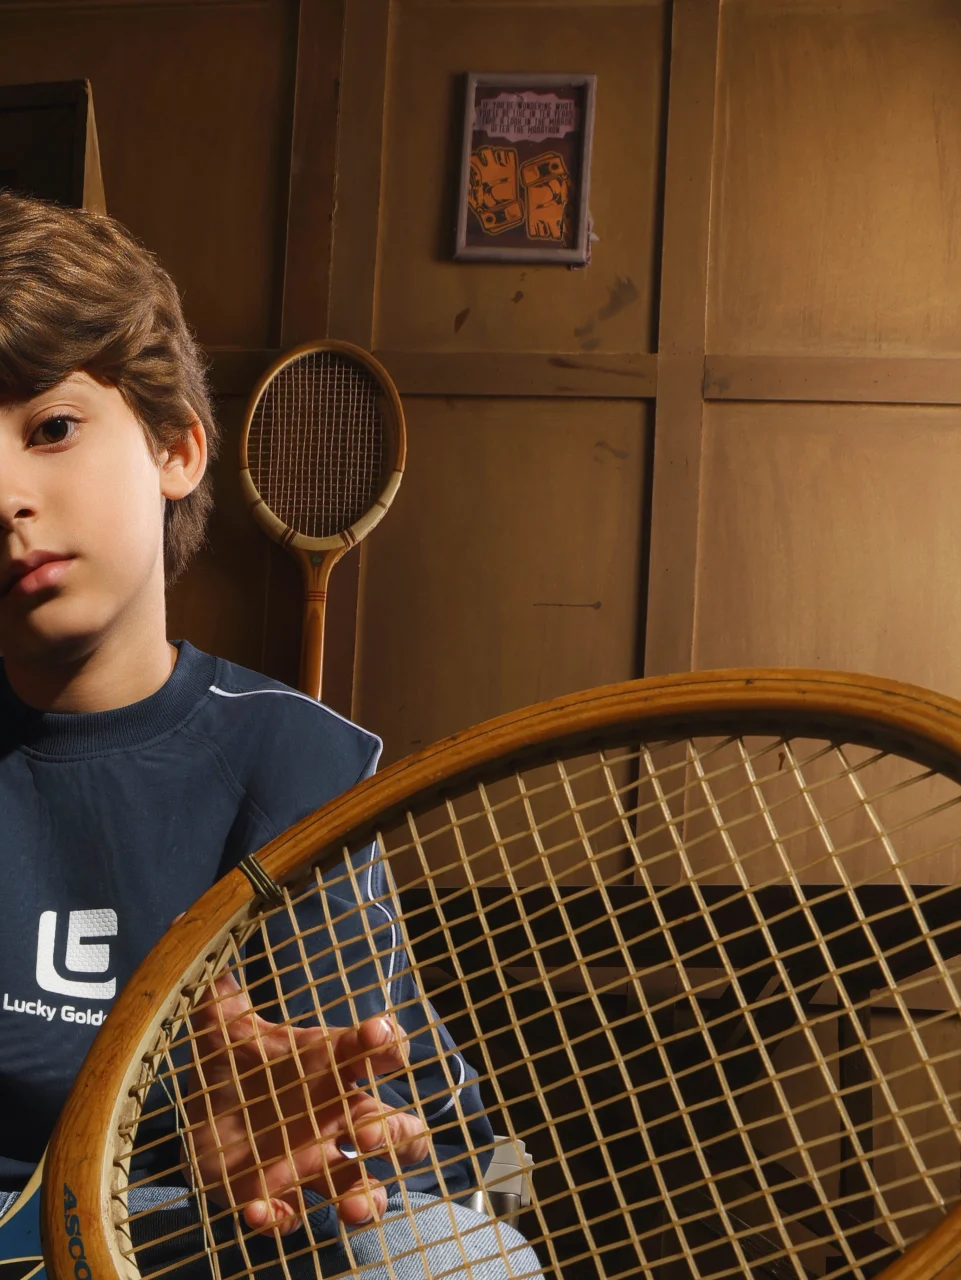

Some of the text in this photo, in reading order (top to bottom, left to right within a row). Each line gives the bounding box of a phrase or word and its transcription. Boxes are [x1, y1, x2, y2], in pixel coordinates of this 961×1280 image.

[517, 101, 551, 110] WONDERING
[555, 102, 571, 110] WHAT
[491, 125, 560, 134] AFTER THE MARATHON
[3, 993, 56, 1021] Lucky
